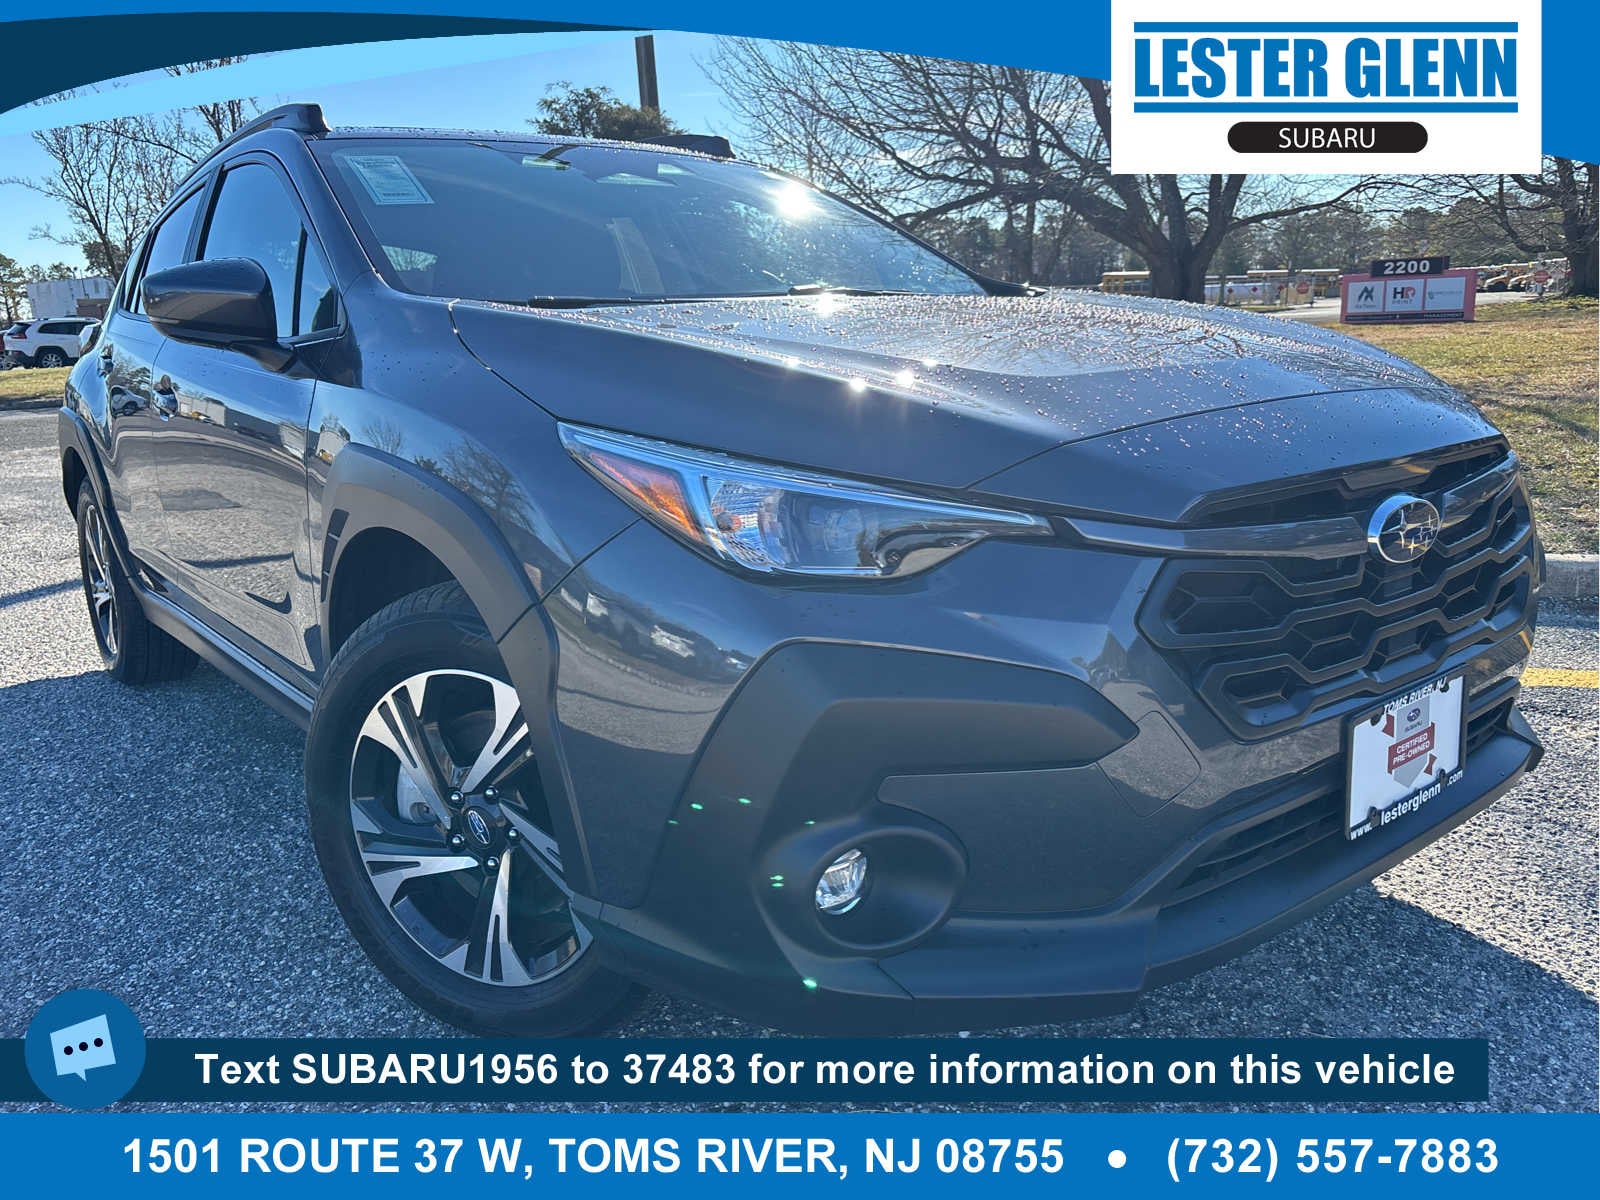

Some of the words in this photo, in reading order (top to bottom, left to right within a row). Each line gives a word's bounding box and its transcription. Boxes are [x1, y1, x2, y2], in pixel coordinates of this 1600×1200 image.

[1383, 260, 1430, 275] 2200
[1383, 695, 1409, 715] TOMS
[1437, 676, 1448, 690] NJ
[1392, 740, 1430, 765] PRE-OWNED
[1396, 732, 1428, 754] CERTIFIED
